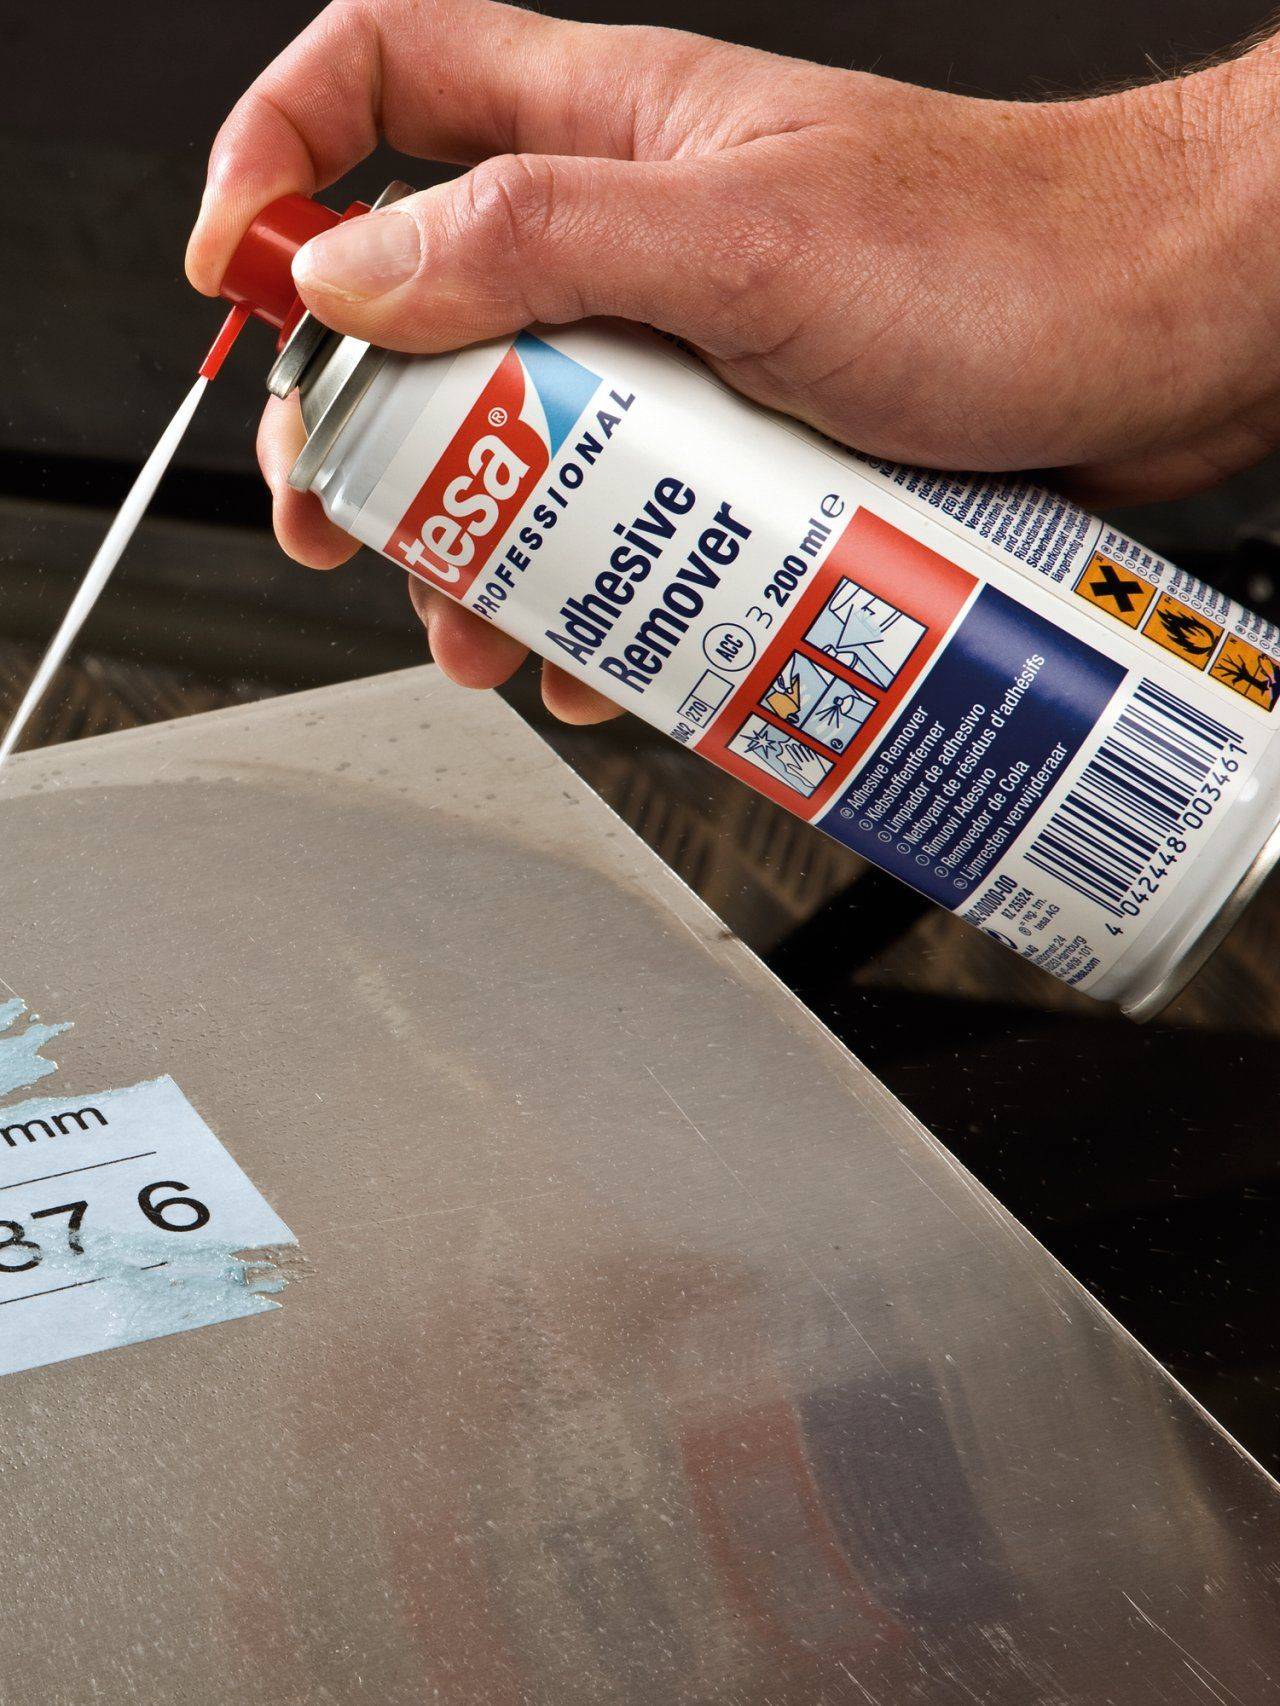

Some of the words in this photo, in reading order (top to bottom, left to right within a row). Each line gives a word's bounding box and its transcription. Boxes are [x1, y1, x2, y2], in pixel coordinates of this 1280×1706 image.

[472, 391, 635, 620] PROFESSIONAL
[941, 496, 959, 515] (EG)
[1003, 534, 1018, 553] und
[1039, 530, 1069, 575] Hautkontakt
[545, 478, 695, 665] Adhesive
[599, 501, 752, 693] Remover
[685, 701, 707, 722] 270
[715, 634, 743, 662] ACC
[764, 555, 807, 607] 200
[799, 518, 831, 557] ml
[848, 764, 888, 810] Adhesive
[880, 705, 928, 764] Remover
[867, 720, 945, 821] Klebstoffentferner
[885, 781, 930, 833] Limpiador
[925, 765, 943, 783] de
[938, 704, 985, 765] adhesivo
[904, 795, 949, 845] Nettoyant
[942, 779, 960, 796] de
[955, 728, 996, 779] résidus
[991, 654, 1045, 727] d'adhésifs
[923, 814, 961, 856] Rimuovi
[954, 768, 996, 818] Adesivo
[941, 809, 993, 868] Removedor
[988, 793, 1006, 810] de
[999, 761, 1030, 791] Cola
[959, 827, 1010, 880] Lijmresten
[1003, 742, 1067, 826] verwijderaar
[1105, 923, 1123, 936] 4
[1120, 836, 1186, 916] 042448
[1182, 743, 1247, 829] 003461
[1001, 908, 1017, 920] RZ
[1008, 887, 1034, 912] 25524
[1021, 907, 1039, 924] reg.
[1030, 895, 1048, 911] tm.
[1033, 914, 1051, 932] tesa
[1043, 902, 1061, 919] AG
[1055, 933, 1088, 963] Hamburg
[0, 1104, 109, 1148] mm
[137, 1180, 211, 1232] 6
